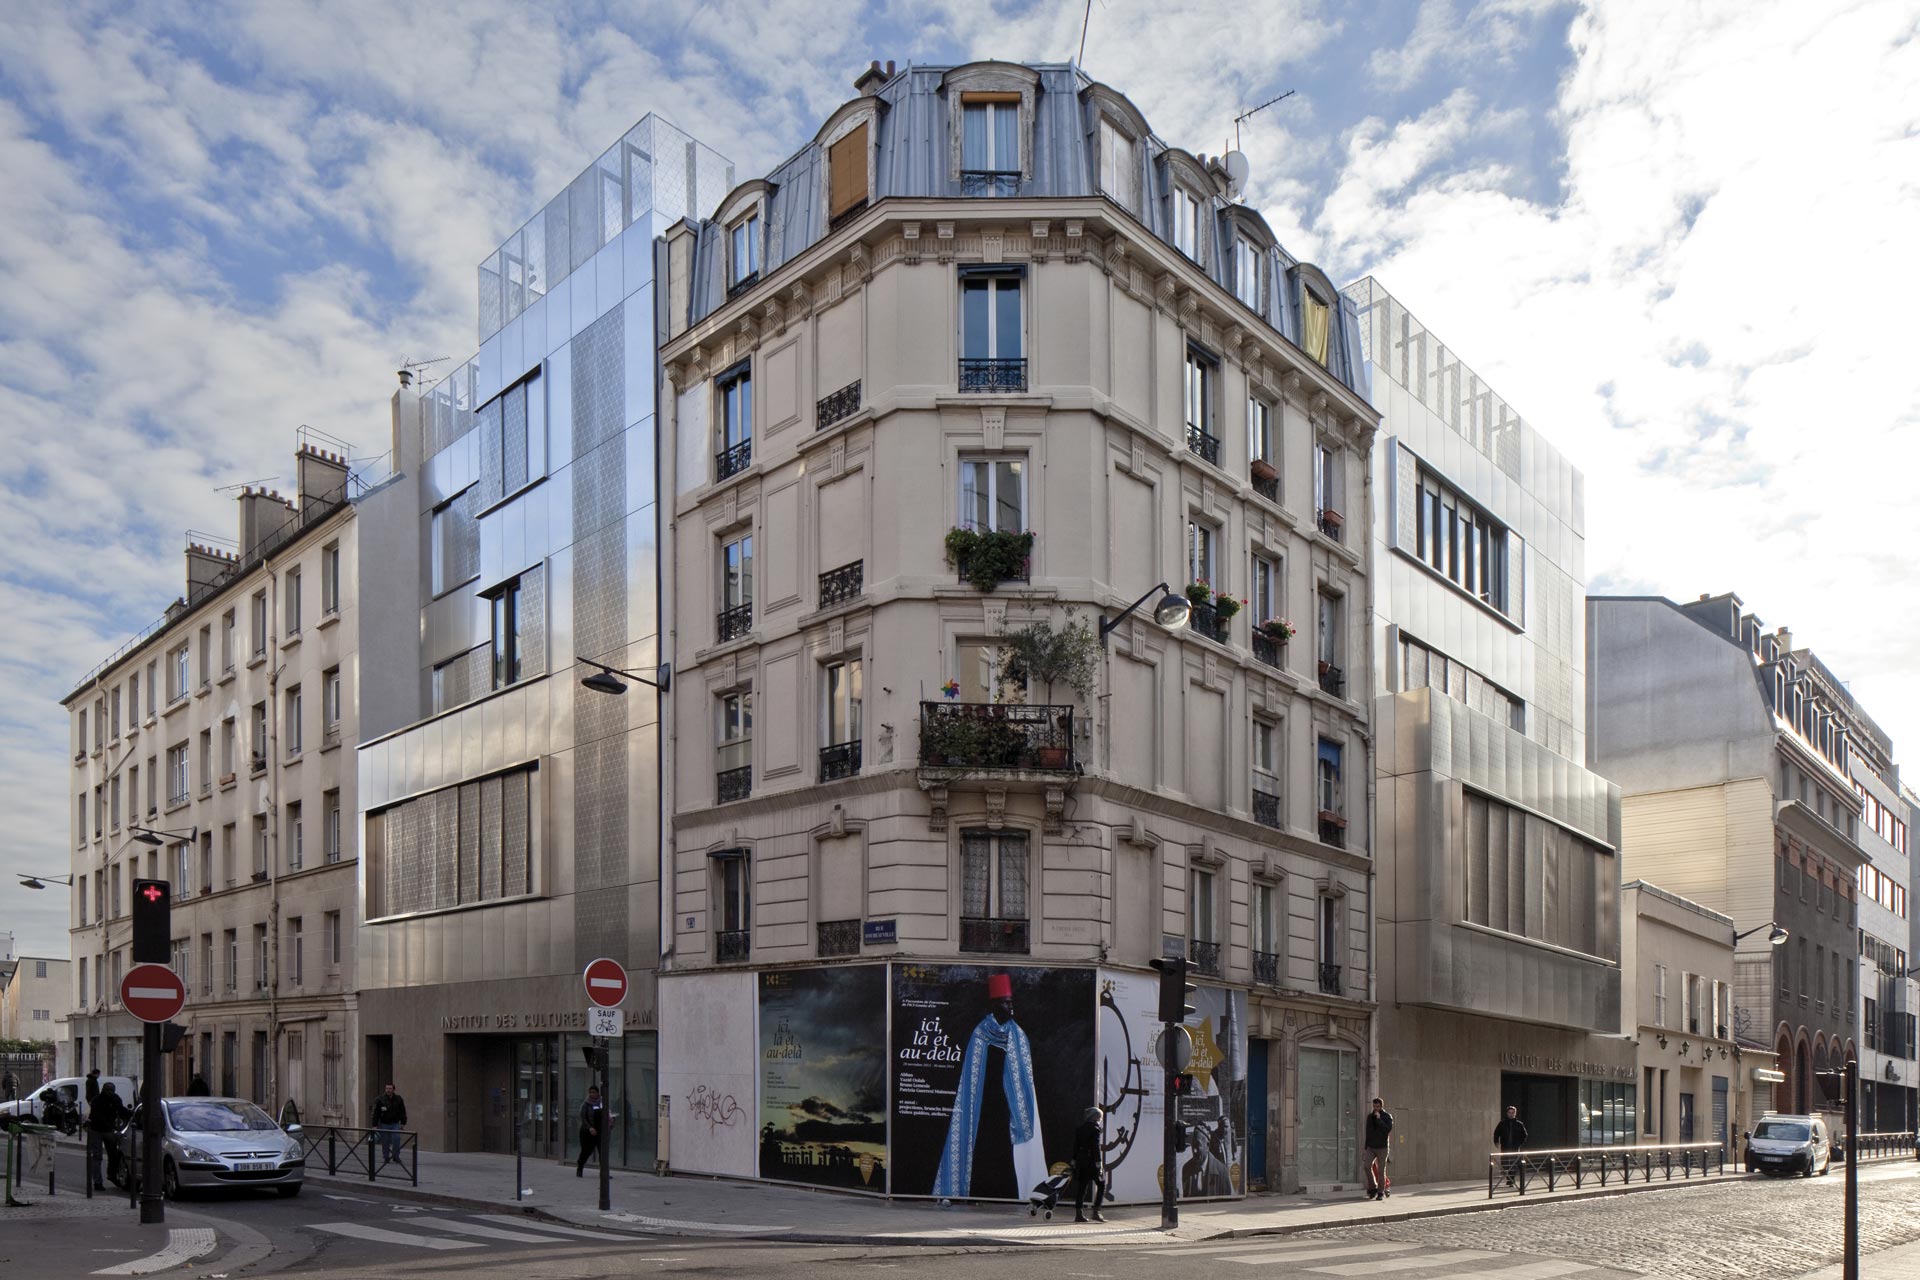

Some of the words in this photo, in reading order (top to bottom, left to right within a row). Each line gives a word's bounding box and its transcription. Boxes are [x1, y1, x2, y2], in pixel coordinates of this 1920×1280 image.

[441, 1014, 489, 1029] INSTITUT
[496, 1014, 517, 1028] DES
[524, 1012, 587, 1027] CULTURES
[597, 1009, 616, 1017] SAUF
[921, 1016, 942, 1035] ici,
[785, 1035, 794, 1046] et
[913, 1030, 929, 1046] là
[933, 1034, 950, 1047] et
[766, 1044, 802, 1059] au-delà
[900, 1044, 962, 1062] au-delà
[1200, 1047, 1208, 1057] et
[1500, 1051, 1540, 1068] INSTITUT
[1548, 1058, 1563, 1071] DES
[1570, 1062, 1606, 1074] CULTURES
